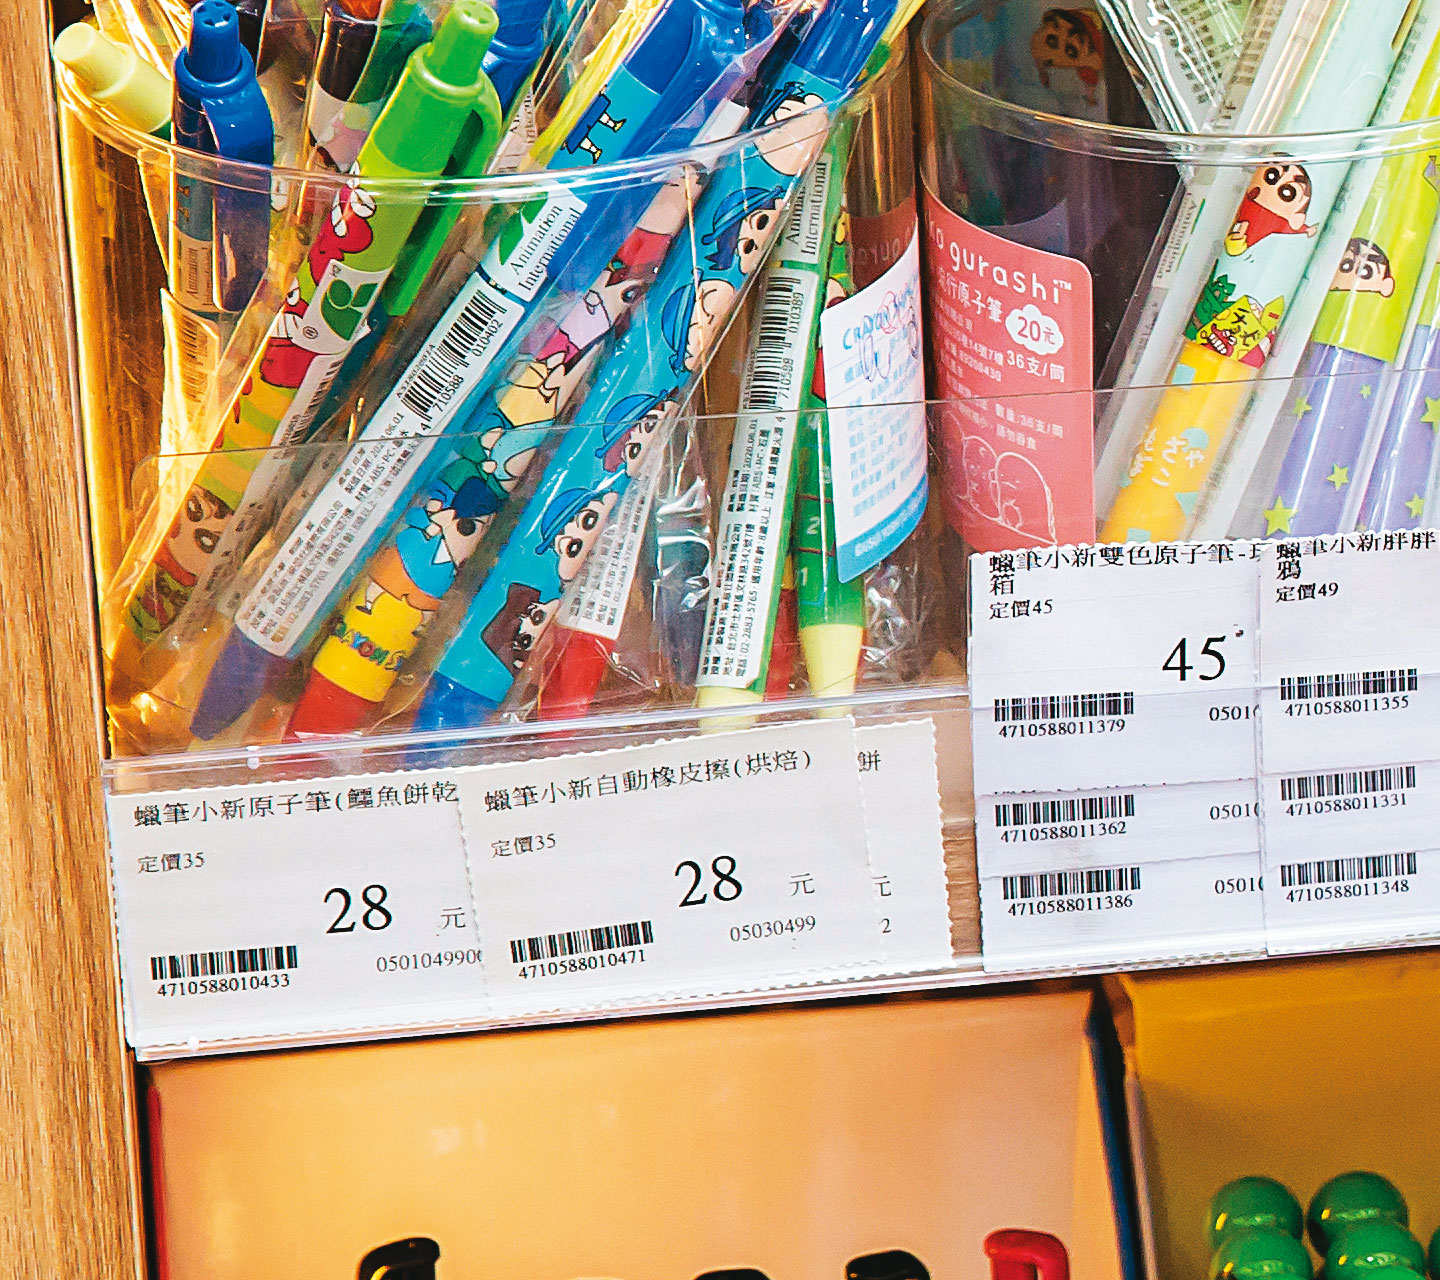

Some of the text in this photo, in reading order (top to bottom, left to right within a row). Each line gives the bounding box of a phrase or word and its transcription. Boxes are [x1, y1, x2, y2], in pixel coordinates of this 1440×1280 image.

[802, 161, 827, 256] International
[510, 204, 581, 292] Animation International
[1162, 635, 1228, 683] 45
[1285, 695, 1410, 718] 4710588011355
[998, 718, 1126, 740] 4710588011379
[1285, 793, 1408, 817] 4710588011331
[491, 832, 557, 859] 定價35
[1000, 820, 1127, 844] 4710588011362
[137, 851, 205, 876] 定價35
[674, 854, 815, 910] 28 元
[1286, 880, 1410, 904] 4710588011348
[323, 884, 467, 936] 28 元
[1008, 894, 1133, 918] 4710588011386
[730, 914, 817, 946] 05030499
[518, 947, 647, 982] 4710588010471
[157, 970, 291, 999] 4710588010433
